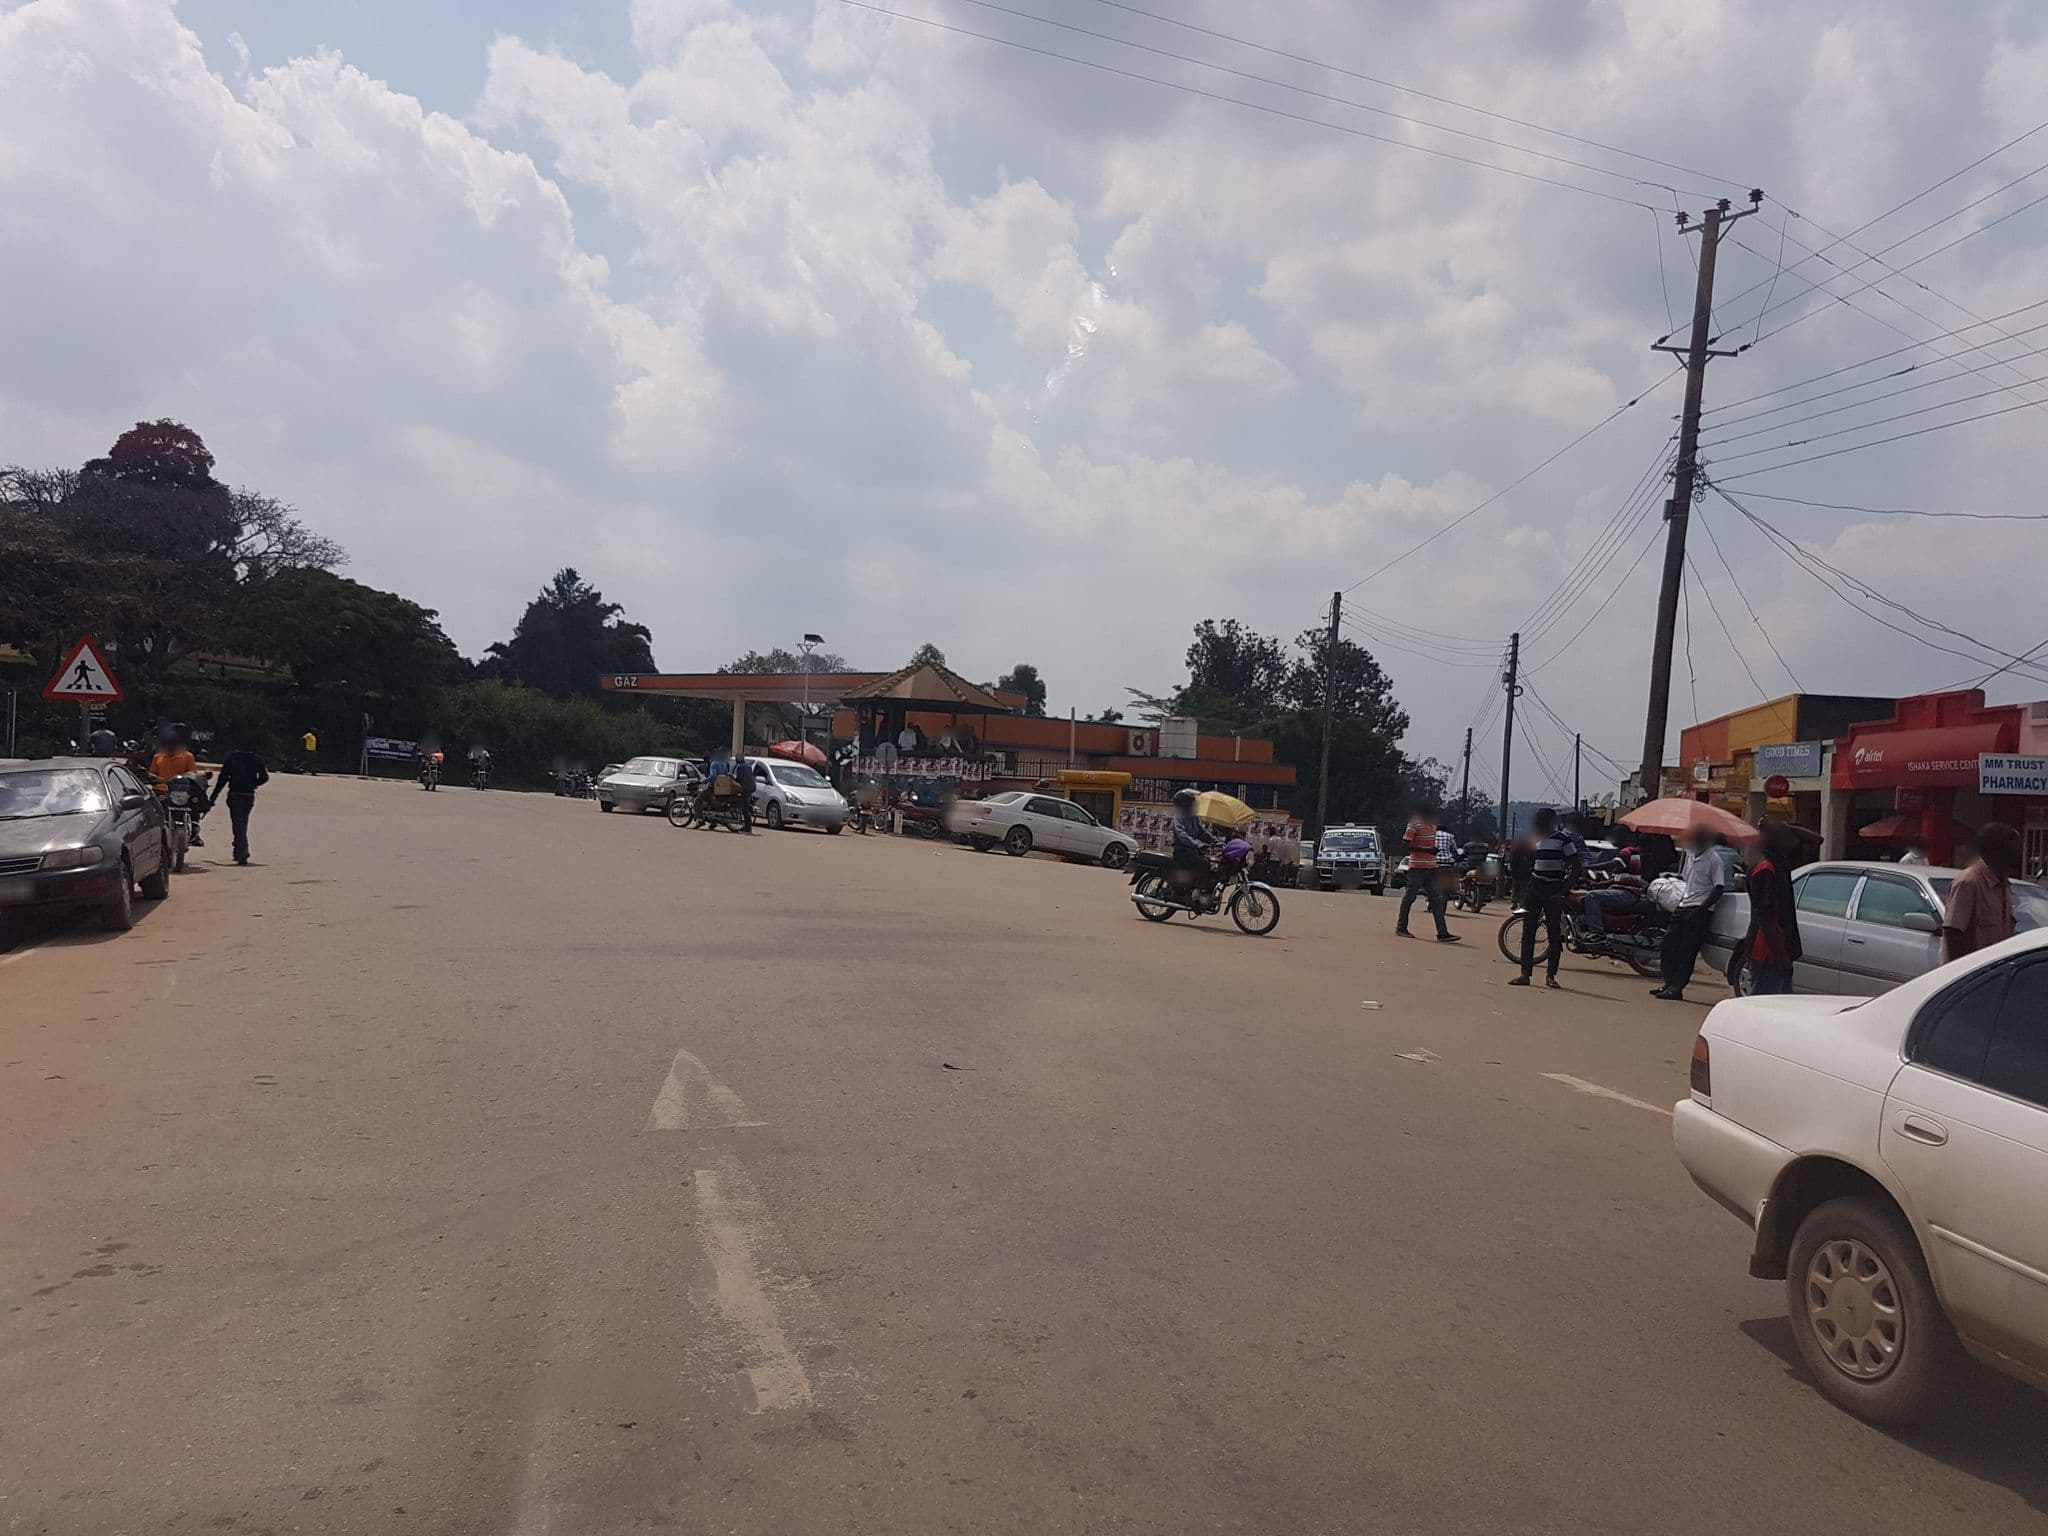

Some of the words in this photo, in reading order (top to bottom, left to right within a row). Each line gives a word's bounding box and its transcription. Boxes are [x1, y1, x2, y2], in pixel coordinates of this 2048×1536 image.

[614, 676, 638, 687] GAZ
[1765, 746, 1784, 758] GOOD
[1786, 744, 1810, 757] TIMES
[1864, 750, 1883, 762] airtel
[1907, 761, 1930, 771] ISHAKA
[1931, 760, 1959, 771] SERVICE
[1984, 759, 2004, 769] MM
[2006, 759, 2045, 770] TRUST
[1982, 775, 2048, 790] PHARMACY
